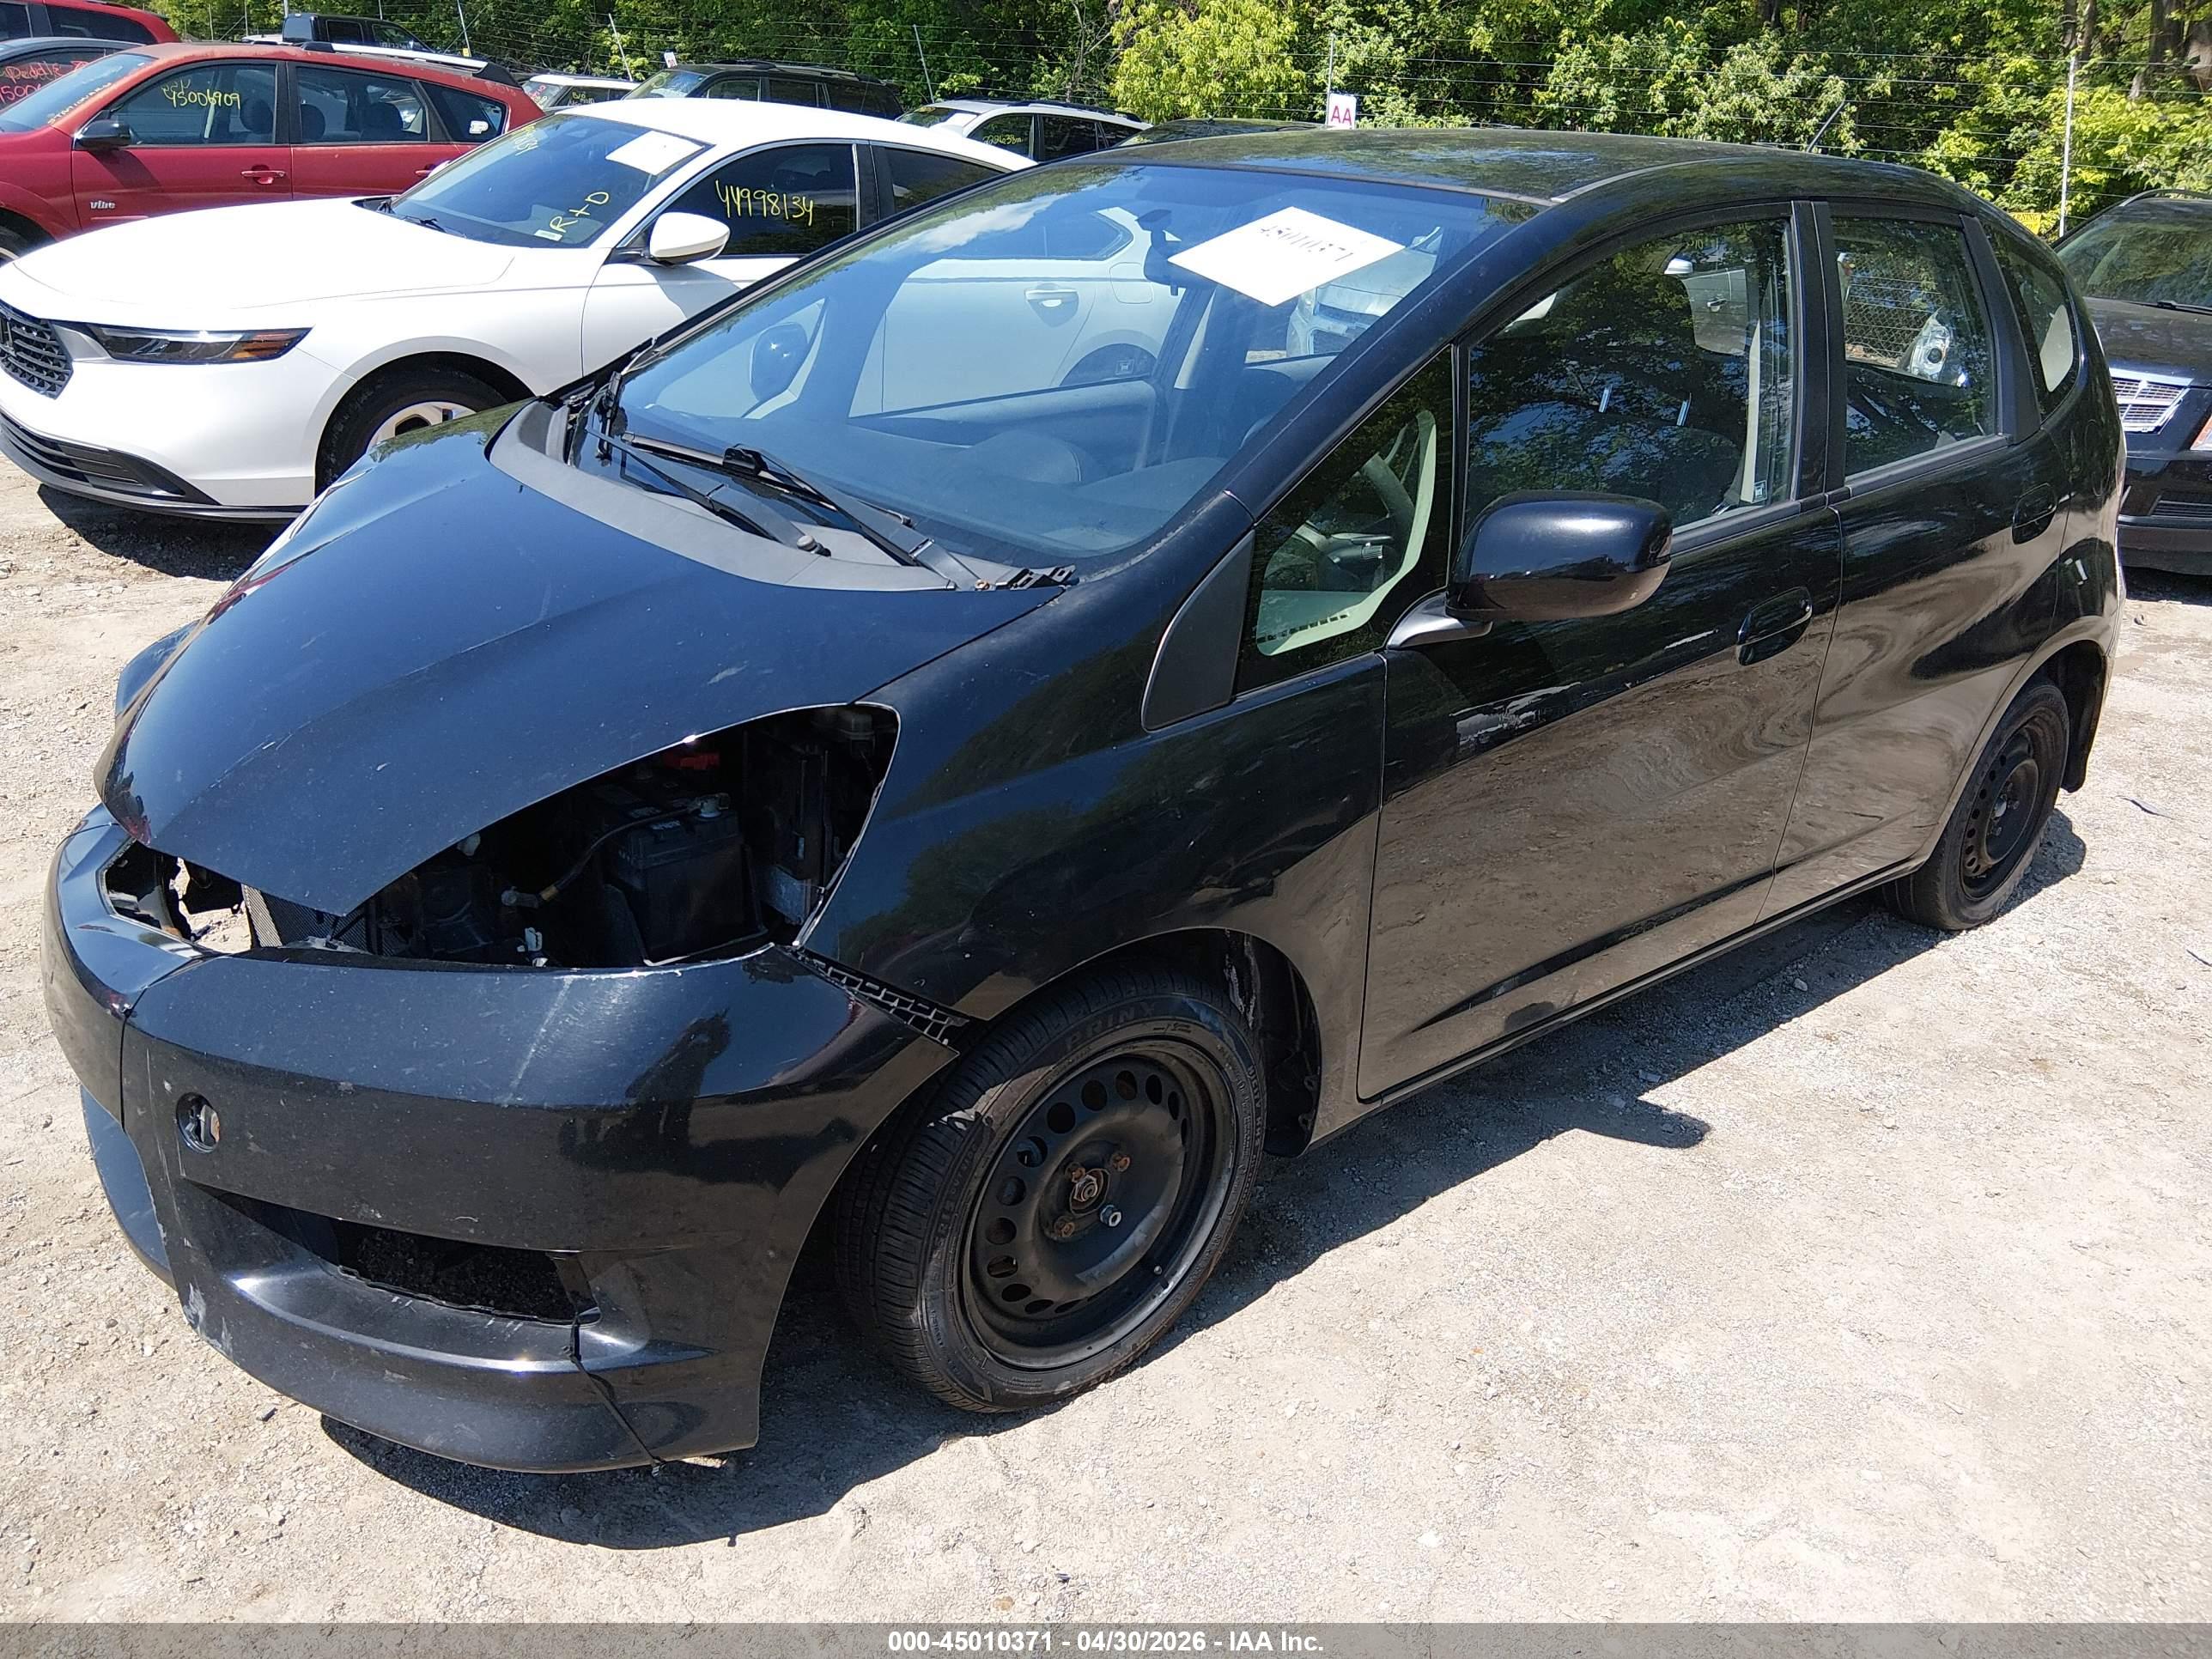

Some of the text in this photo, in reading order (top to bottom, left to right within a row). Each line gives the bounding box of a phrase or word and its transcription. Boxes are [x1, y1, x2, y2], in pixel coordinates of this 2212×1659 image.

[162, 88, 241, 110] 45006909
[1331, 105, 1352, 126] AA
[715, 179, 814, 227] 44998134
